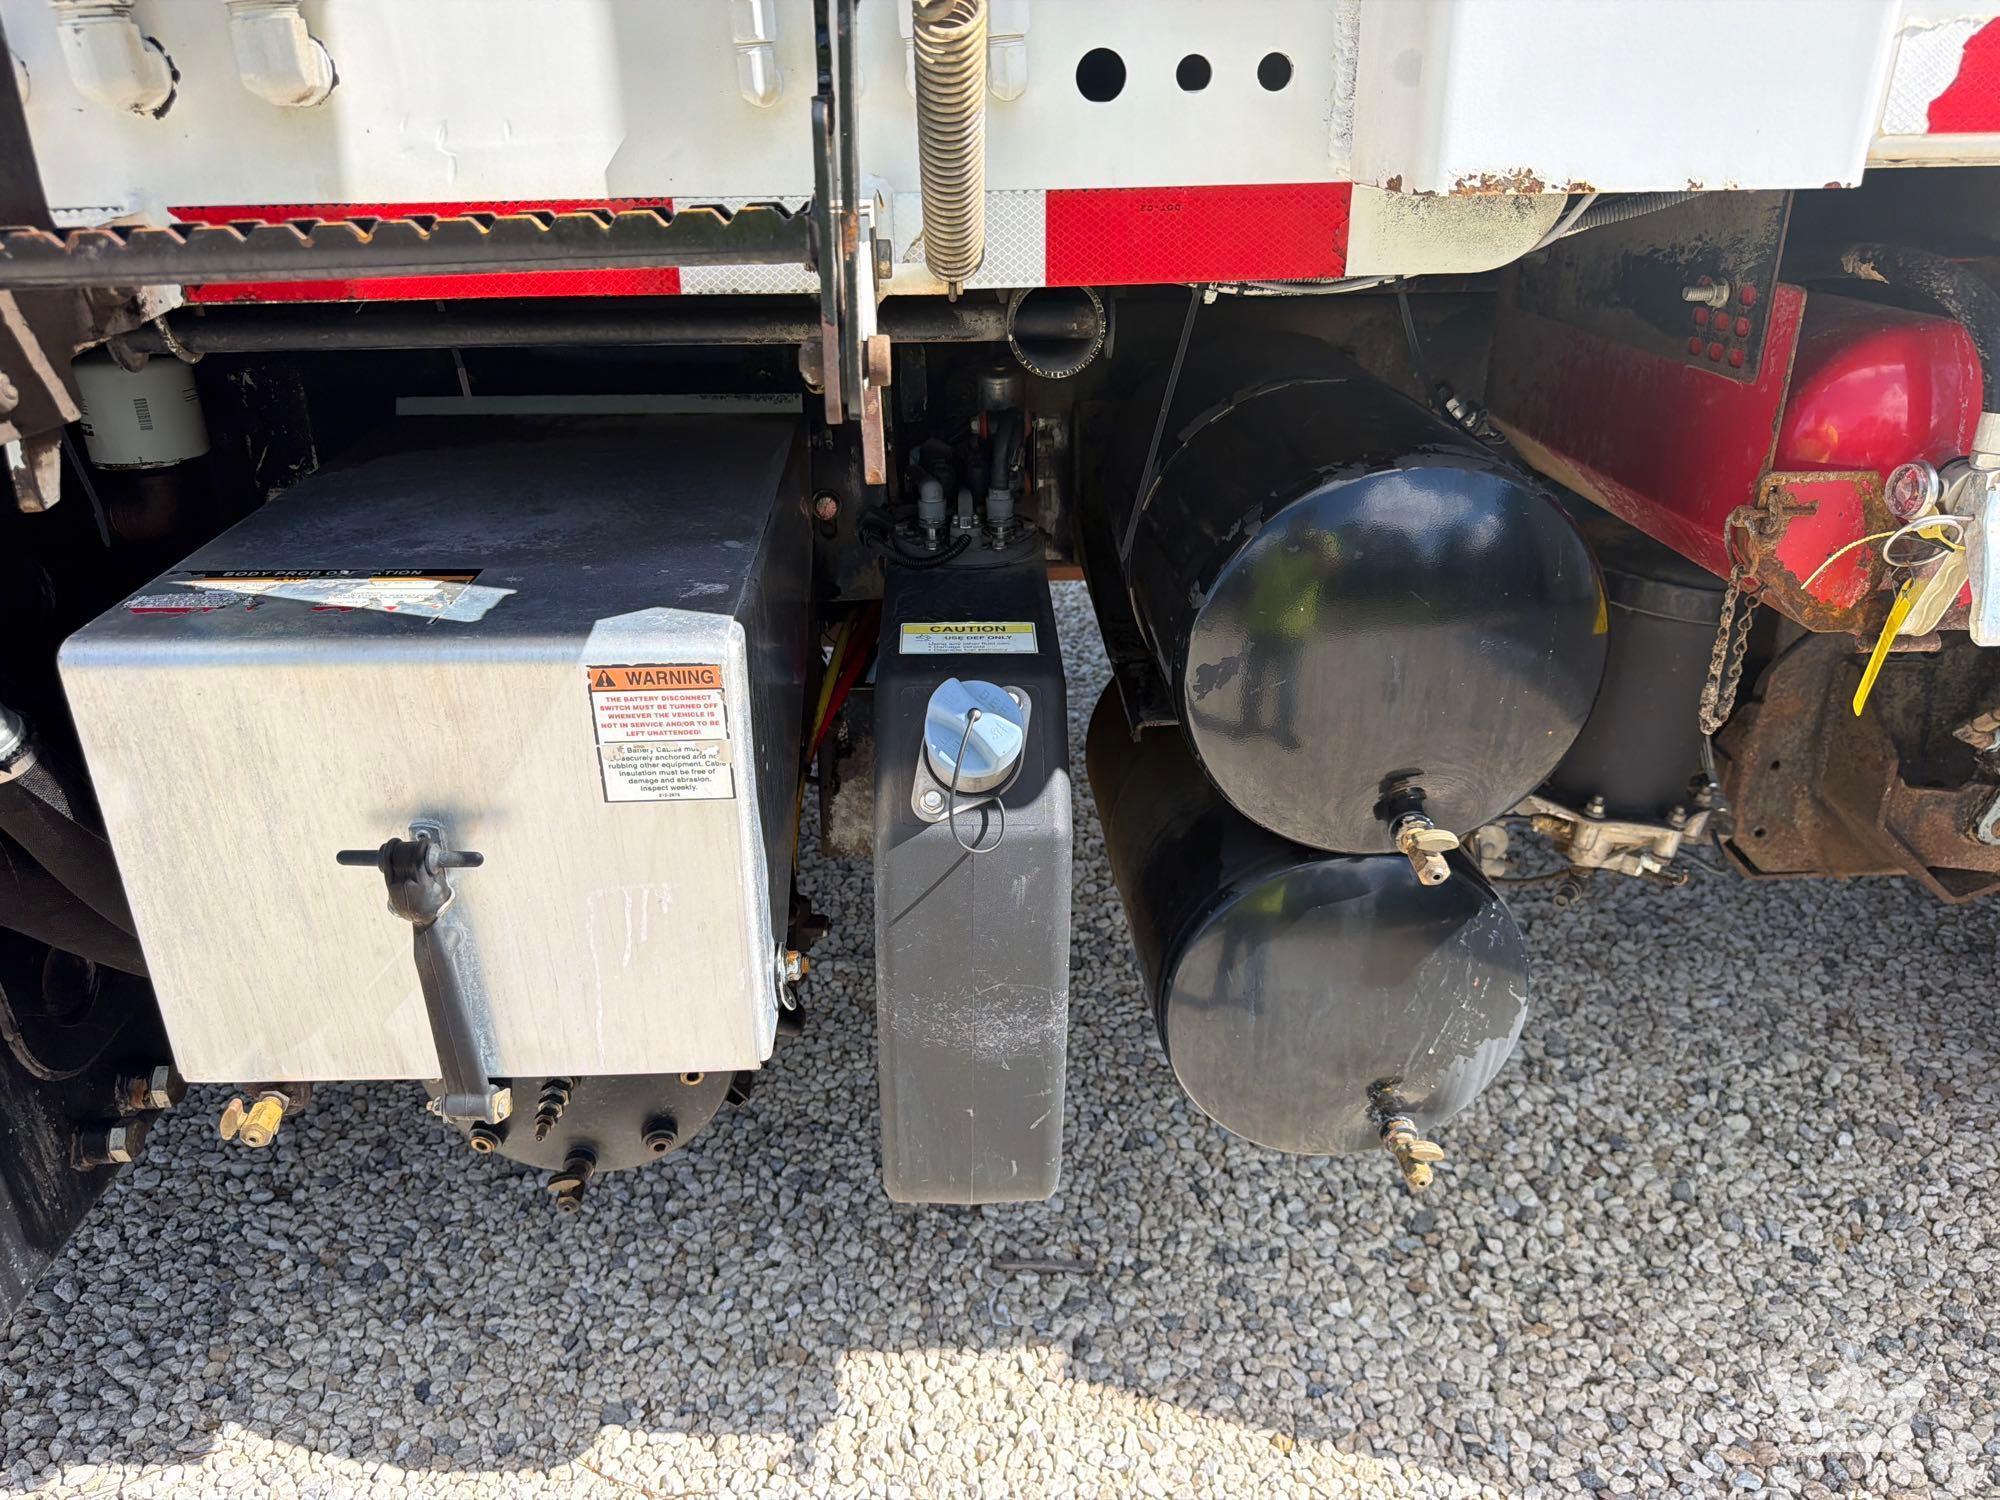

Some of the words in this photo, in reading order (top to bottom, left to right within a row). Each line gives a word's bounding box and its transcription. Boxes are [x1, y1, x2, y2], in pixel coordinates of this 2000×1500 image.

[930, 625, 1006, 633] CAUTION
[625, 669, 714, 686] WARNING
[621, 754, 653, 762] securely
[655, 753, 690, 761] anchored
[608, 762, 638, 770] rubbing
[639, 761, 659, 769] other
[661, 761, 702, 769] equipment.
[680, 768, 690, 776] be
[628, 777, 658, 785] damage
[640, 785, 668, 793] Inspect
[670, 784, 698, 792] weekly.
